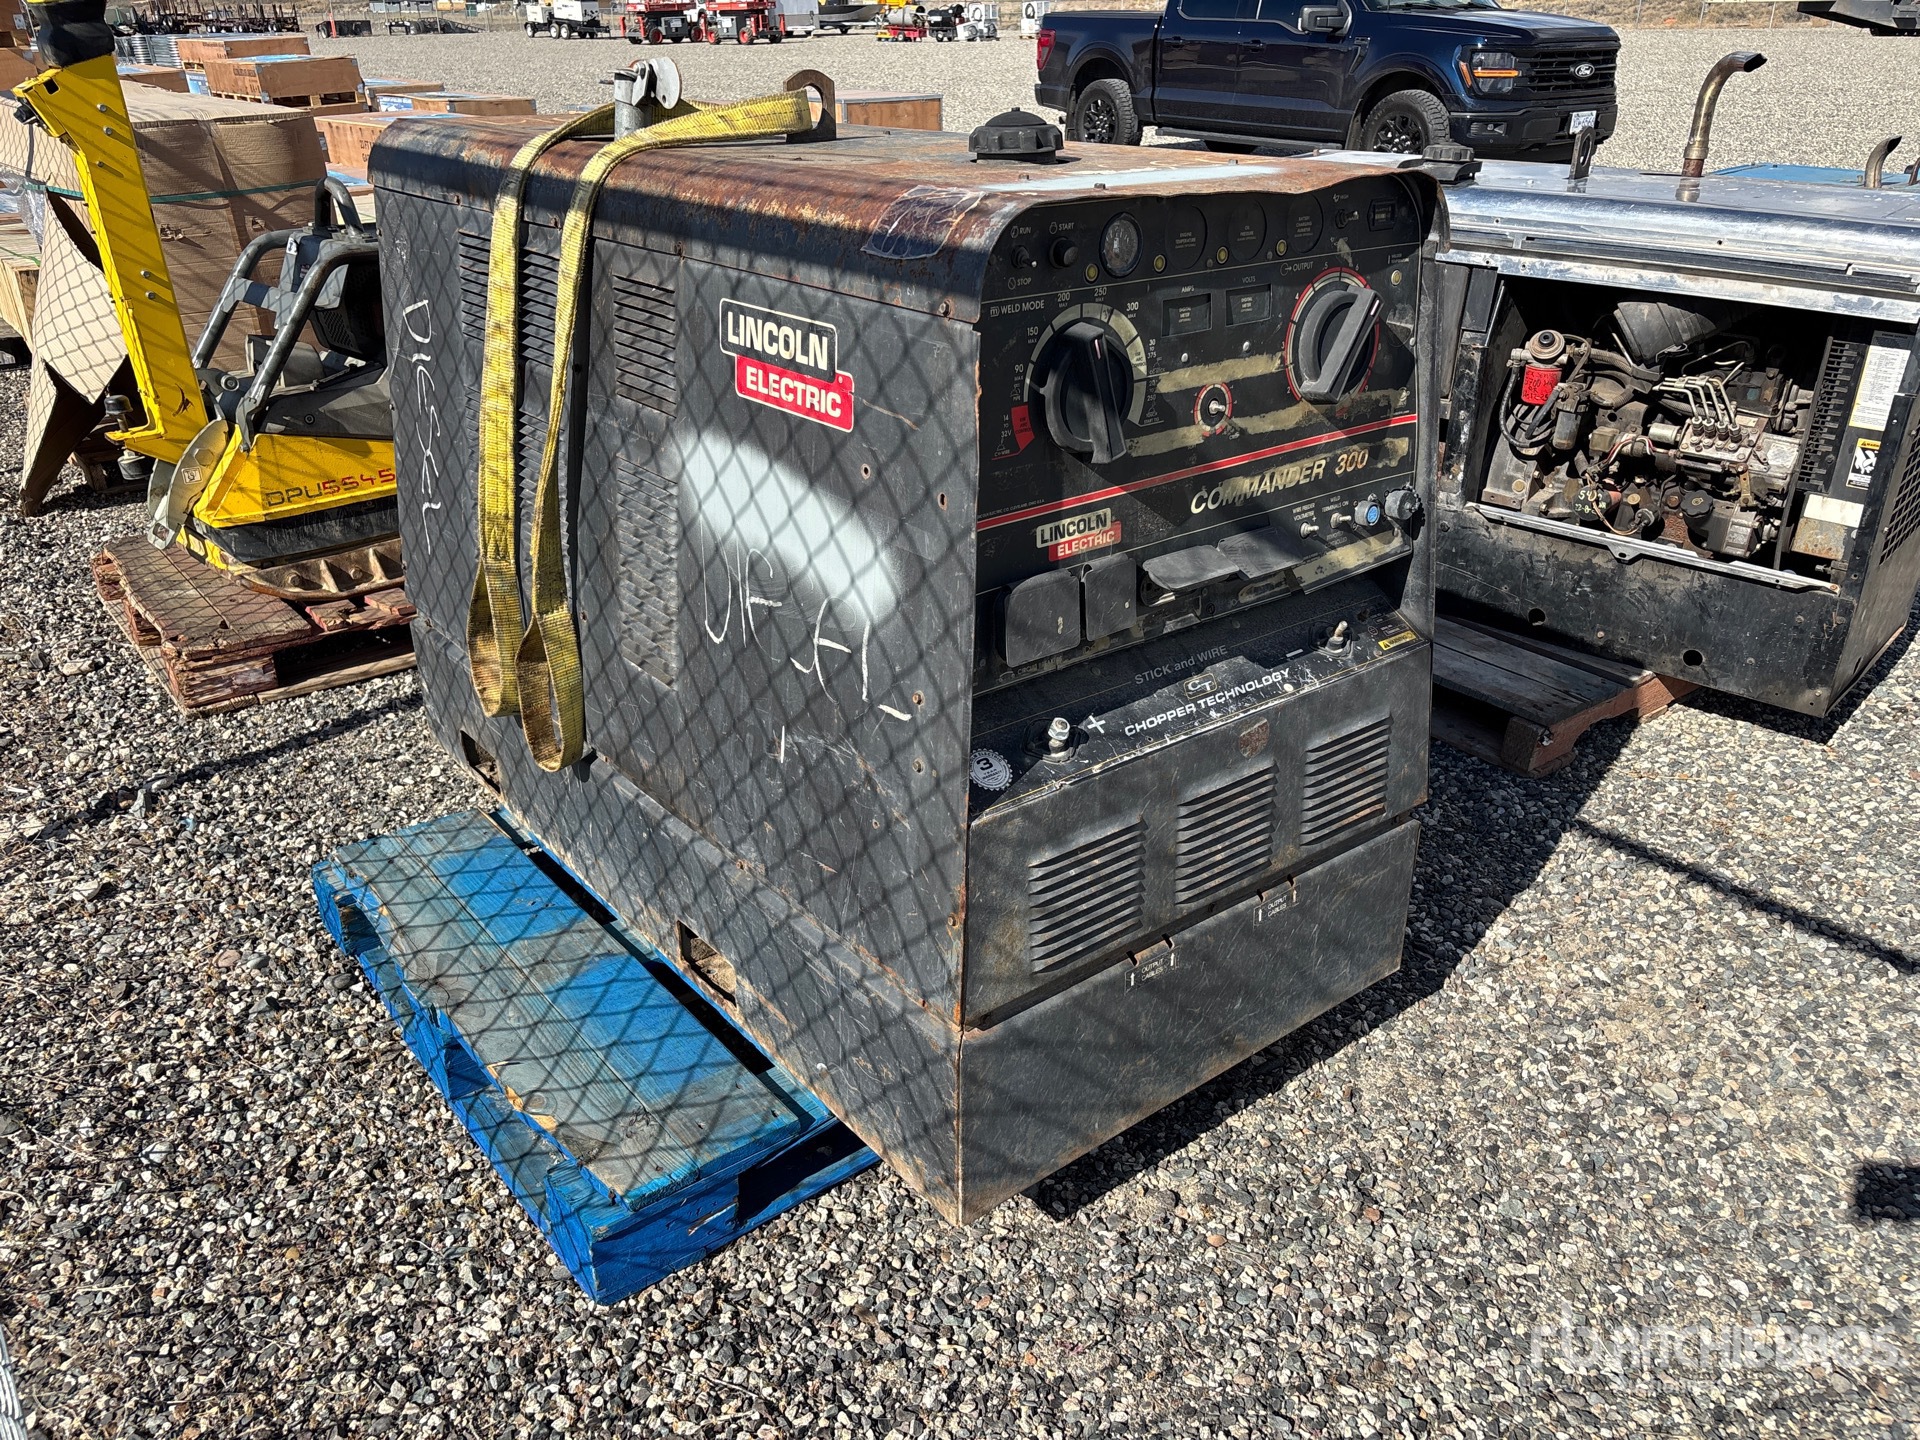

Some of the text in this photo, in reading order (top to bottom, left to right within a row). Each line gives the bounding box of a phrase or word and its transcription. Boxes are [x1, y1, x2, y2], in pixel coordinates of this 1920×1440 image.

[1293, 262, 1313, 271] OUTPUT
[1018, 278, 1031, 286] STOP
[1094, 287, 1107, 296] 250
[1182, 285, 1194, 293] AMPS
[1058, 292, 1070, 302] 200
[1001, 300, 1044, 314] WELD MODE
[1126, 302, 1139, 311] 300
[1027, 326, 1038, 336] 150
[728, 311, 827, 370] LINCOLN
[1015, 364, 1023, 373] 90
[746, 365, 841, 418] ELECTRIC
[265, 468, 396, 507] DPU5545
[1190, 449, 1369, 514] COMMANDER 300
[1322, 503, 1341, 512] TERMINALS
[1040, 512, 1107, 544] LINCOLN
[1057, 531, 1115, 557] ELECTRIC
[1135, 644, 1228, 685] STICK and WIRE
[1188, 680, 1212, 691] CT
[1124, 668, 1290, 737] CHOPPER TECHNOLOGY
[977, 758, 993, 770] 3
[1267, 894, 1287, 909] OUTPUT
[1267, 903, 1287, 917] CABLES
[1141, 958, 1164, 974] OUTPUT
[1141, 967, 1164, 980] CABLES
